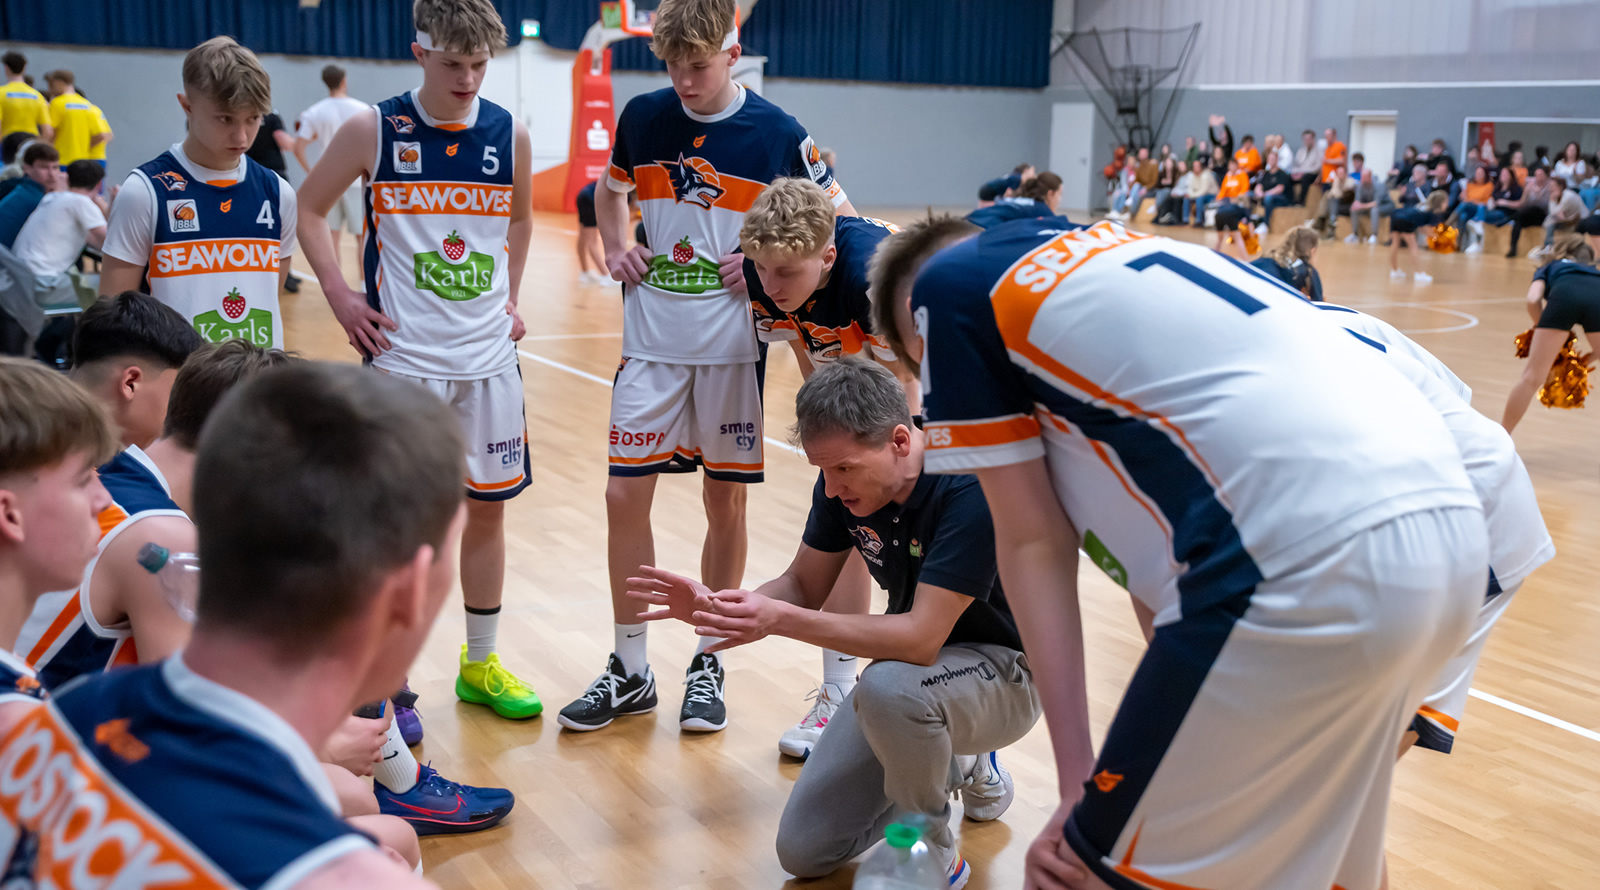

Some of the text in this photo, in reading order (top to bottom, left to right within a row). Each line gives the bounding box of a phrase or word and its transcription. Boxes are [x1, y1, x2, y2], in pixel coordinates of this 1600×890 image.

[481, 145, 500, 176] 5
[381, 185, 512, 213] SEAWOLVES
[174, 218, 195, 231] JBBL
[256, 200, 275, 230] 4
[157, 243, 279, 273] SEAWOLVE
[1014, 220, 1134, 293] SEAW
[421, 261, 492, 288] Karls
[648, 263, 719, 286] Karls
[198, 318, 269, 344] Karls
[920, 661, 996, 688] Champion
[0, 724, 194, 890] OSTOCK
